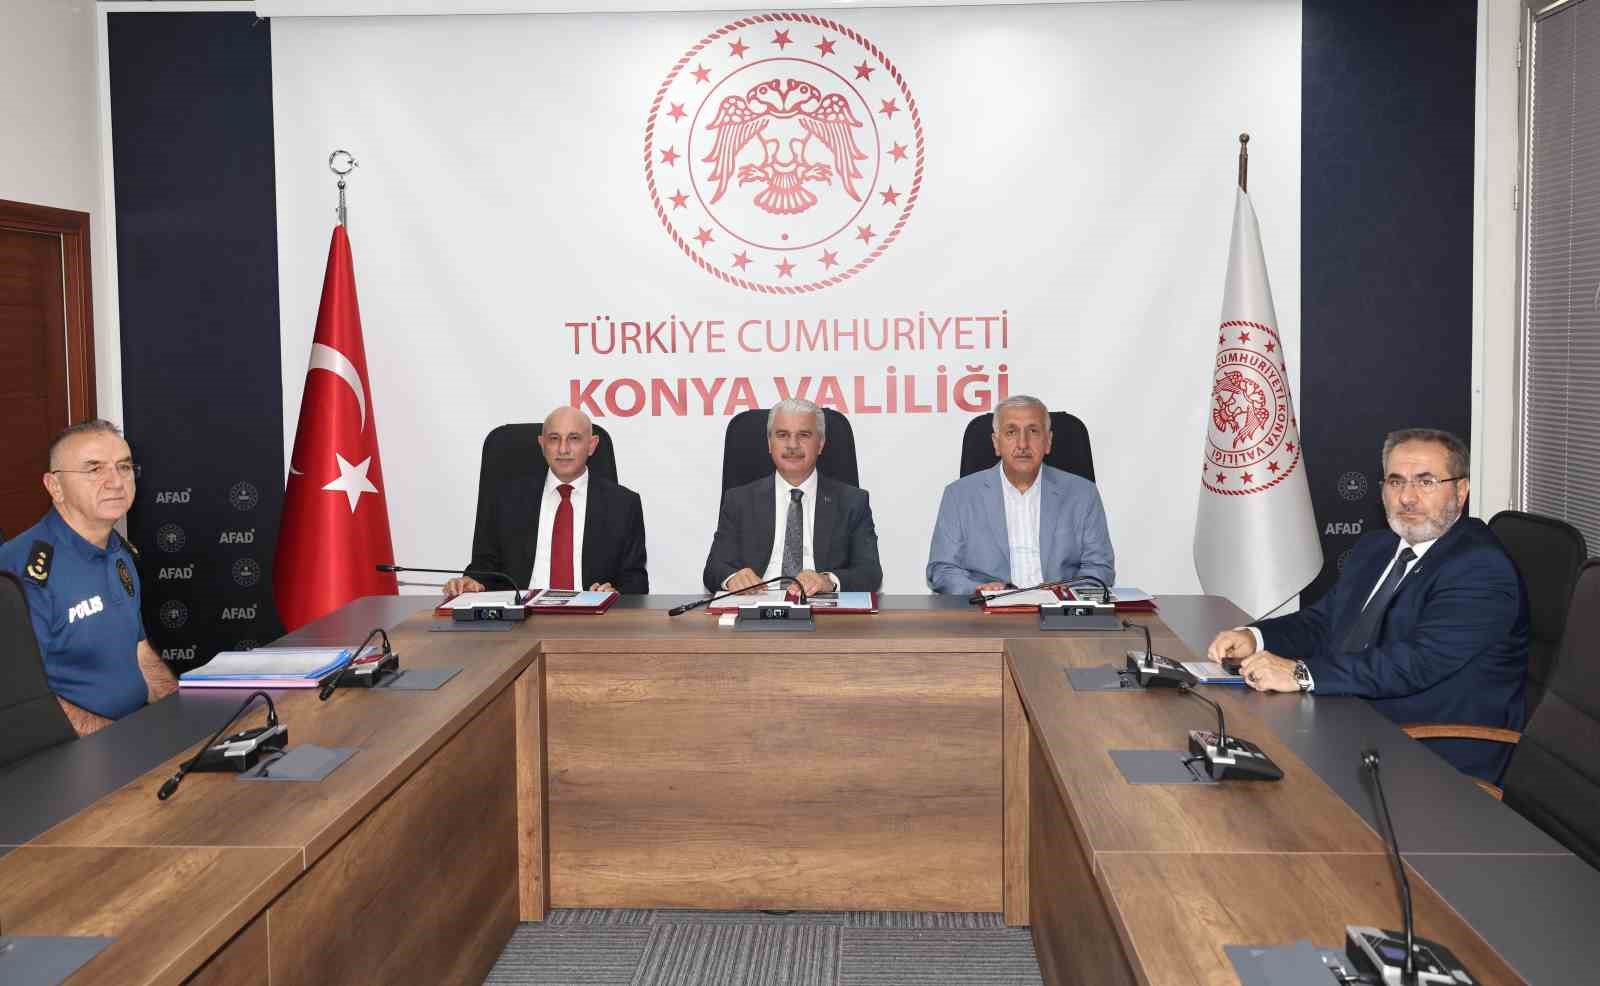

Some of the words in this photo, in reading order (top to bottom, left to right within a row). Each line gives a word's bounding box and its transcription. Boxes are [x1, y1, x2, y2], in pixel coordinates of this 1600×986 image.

[565, 315, 726, 354] TÜRKİYE
[737, 310, 1009, 352] CUMHURİYETİ
[569, 377, 760, 418] KONYA
[773, 364, 1009, 415] VALİLİĞİ
[1265, 403, 1286, 448] KONYA
[156, 490, 190, 504] AFAD
[1325, 521, 1362, 535] AFAD
[219, 530, 254, 544] AFAD
[158, 566, 193, 580] AFAD
[221, 606, 256, 620] AFAD
[162, 646, 195, 660] AFAD
